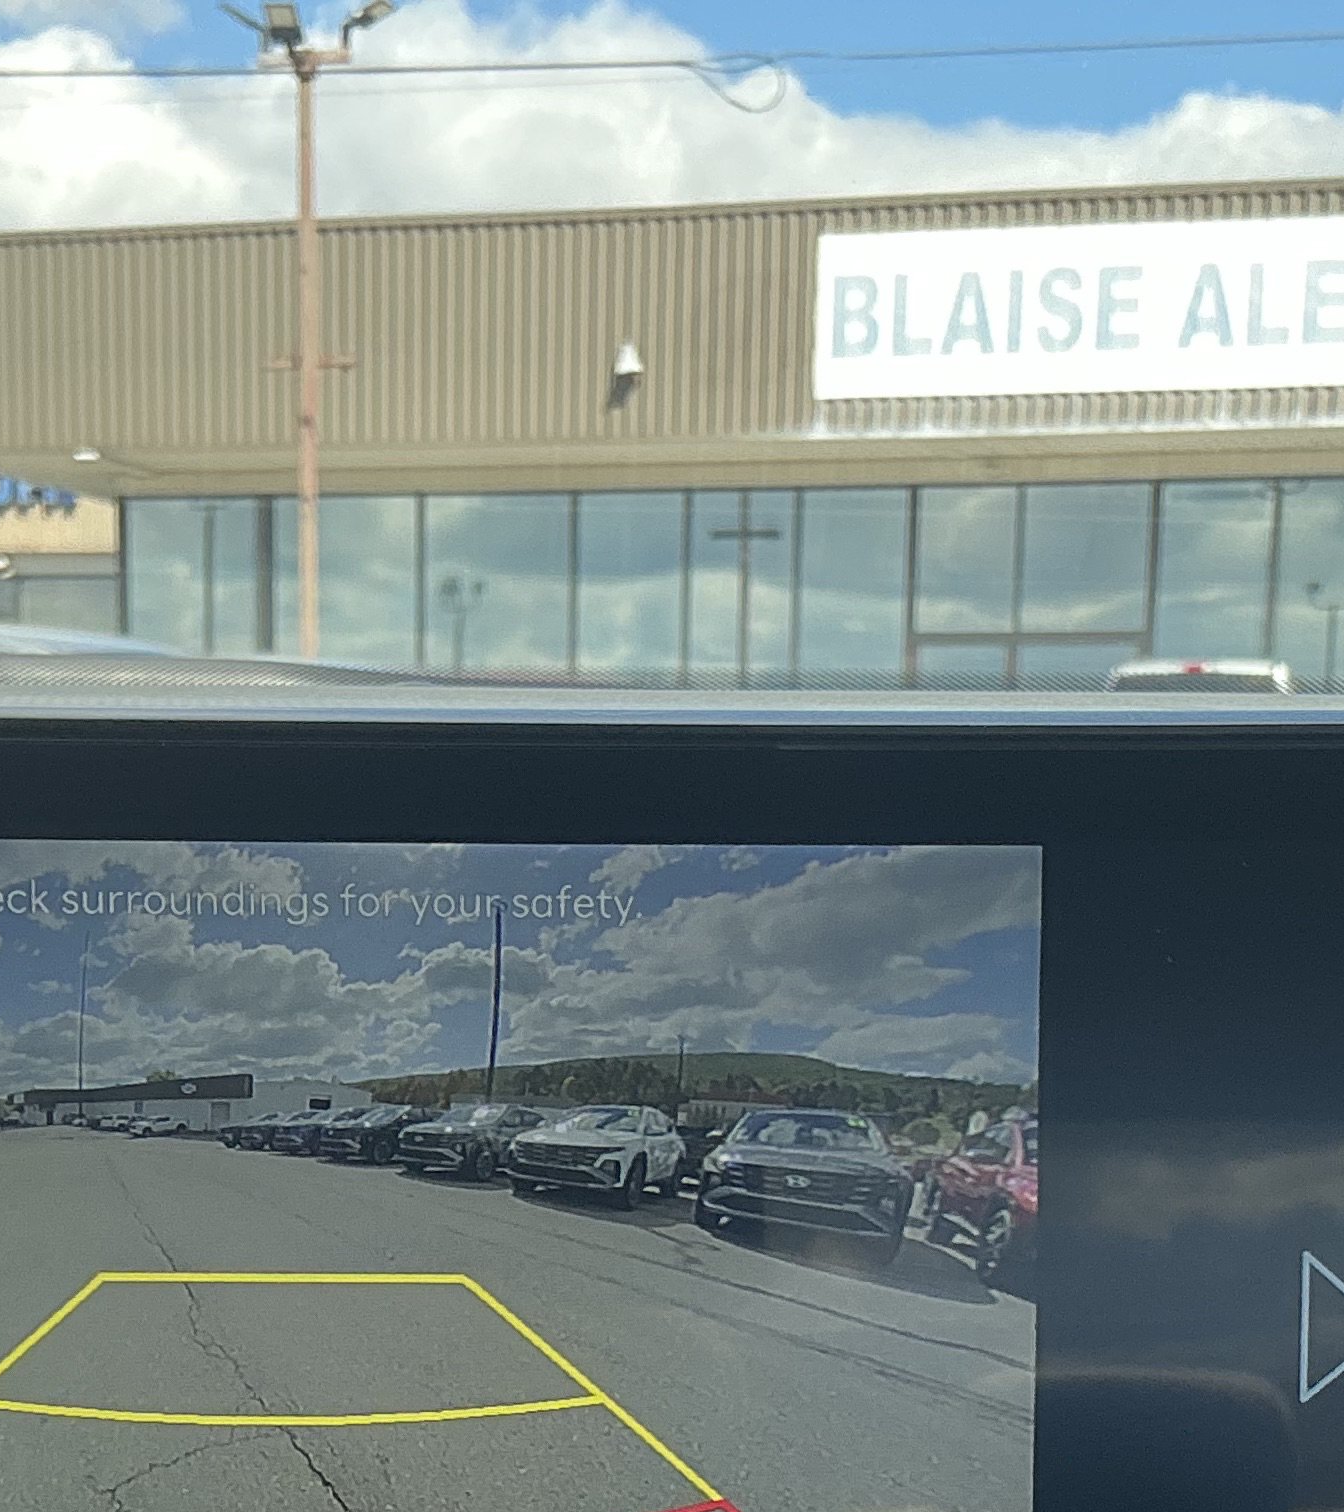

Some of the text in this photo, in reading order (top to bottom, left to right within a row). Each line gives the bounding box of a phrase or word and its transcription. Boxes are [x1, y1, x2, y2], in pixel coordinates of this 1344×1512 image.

[830, 266, 1144, 359] BLAISE
[60, 878, 330, 926] surroundings
[340, 880, 395, 920] for
[412, 890, 506, 928] your
[513, 882, 644, 928] safety.
